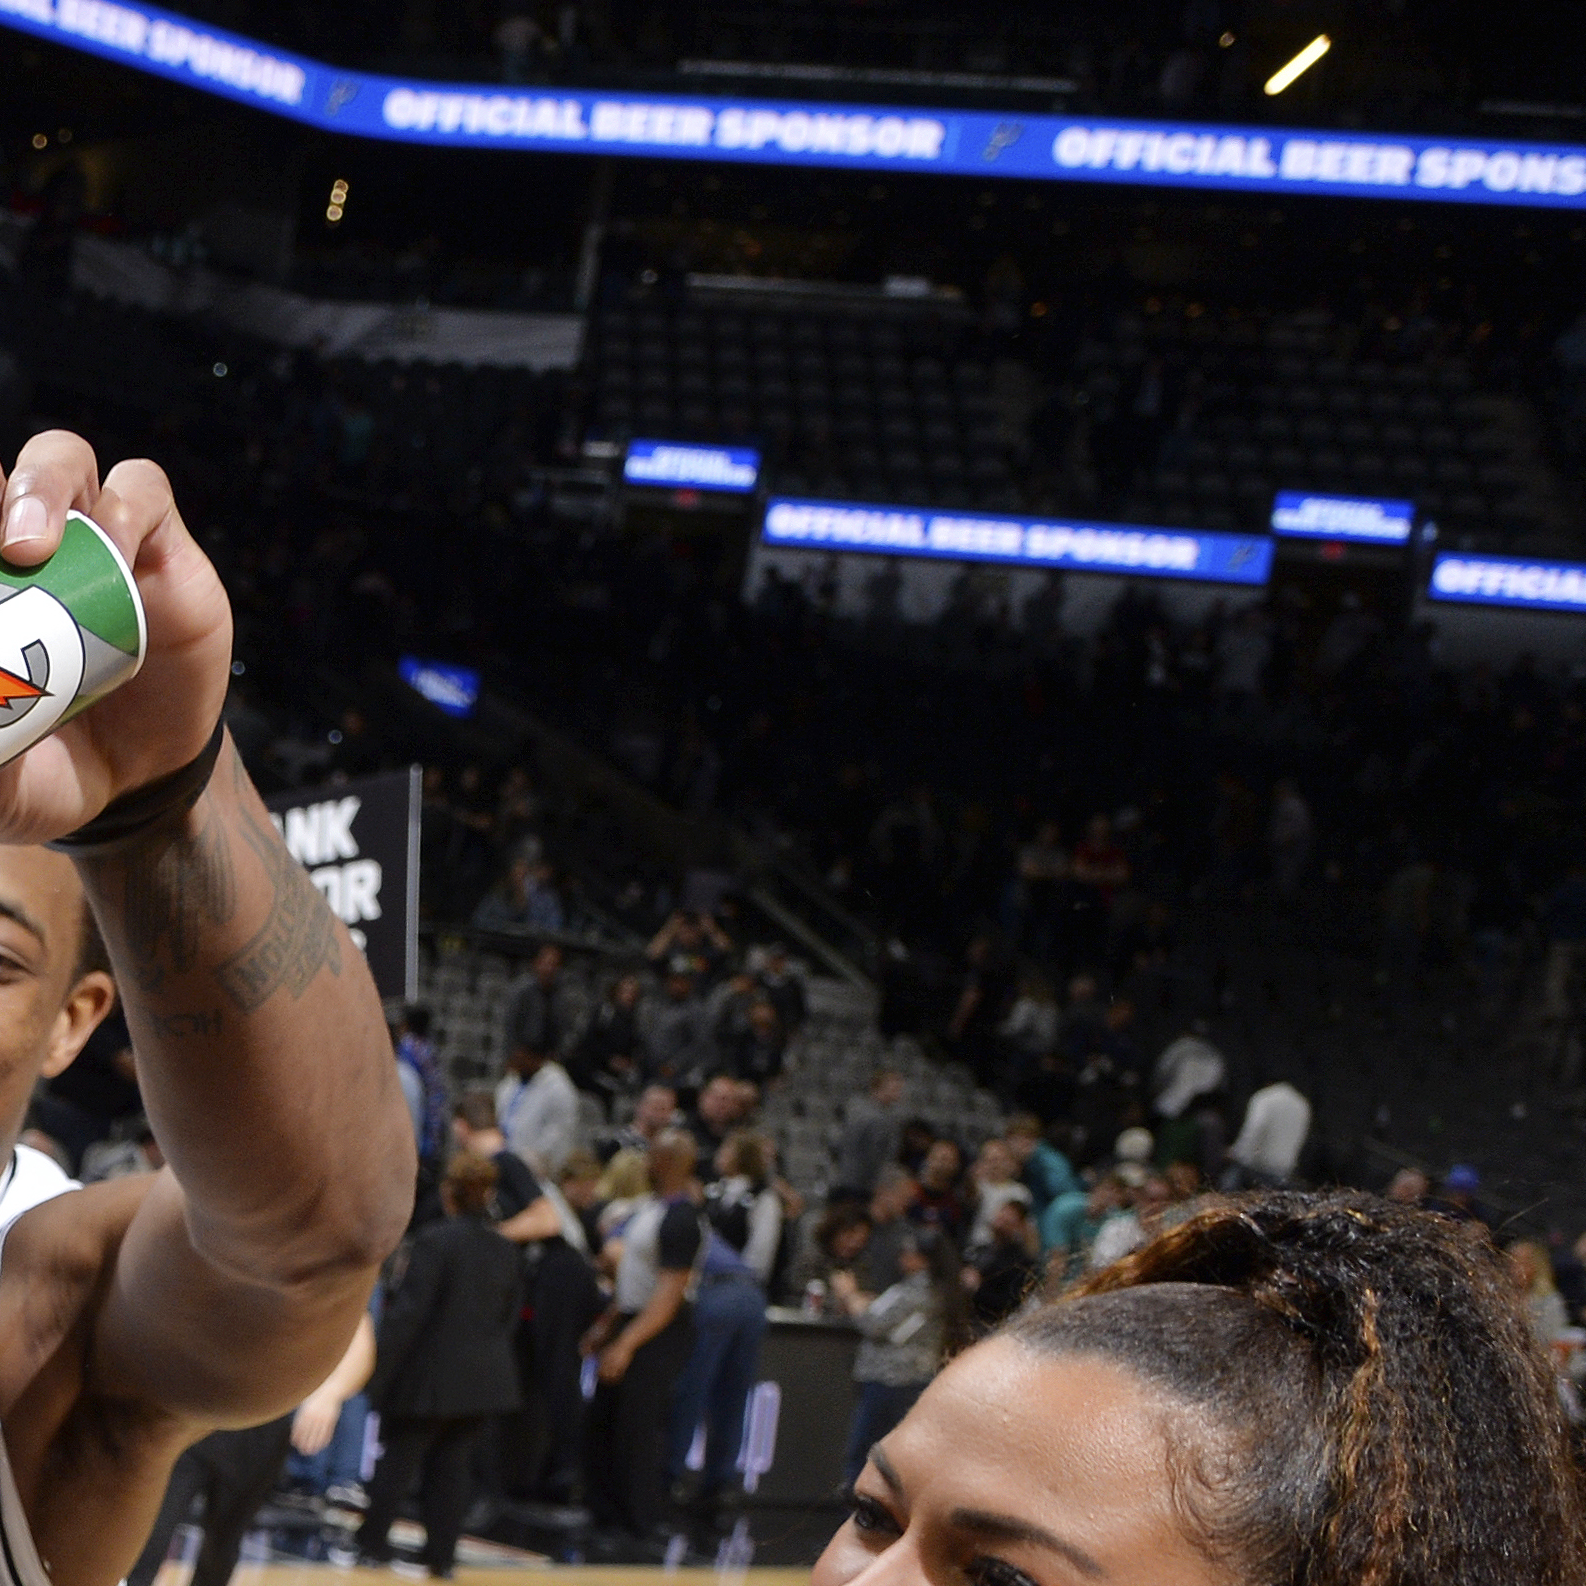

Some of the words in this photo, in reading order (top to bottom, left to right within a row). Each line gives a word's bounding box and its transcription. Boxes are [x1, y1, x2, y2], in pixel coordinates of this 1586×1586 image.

[58, 0, 150, 55] BEER
[148, 18, 307, 106] SPONSOR
[383, 89, 590, 140] OFFICIAL
[591, 96, 715, 147] BEER
[716, 106, 945, 159] SPONSOR
[1053, 125, 1276, 179] OFFICIAL
[1278, 139, 1415, 188] BEER
[270, 795, 362, 866] NK
